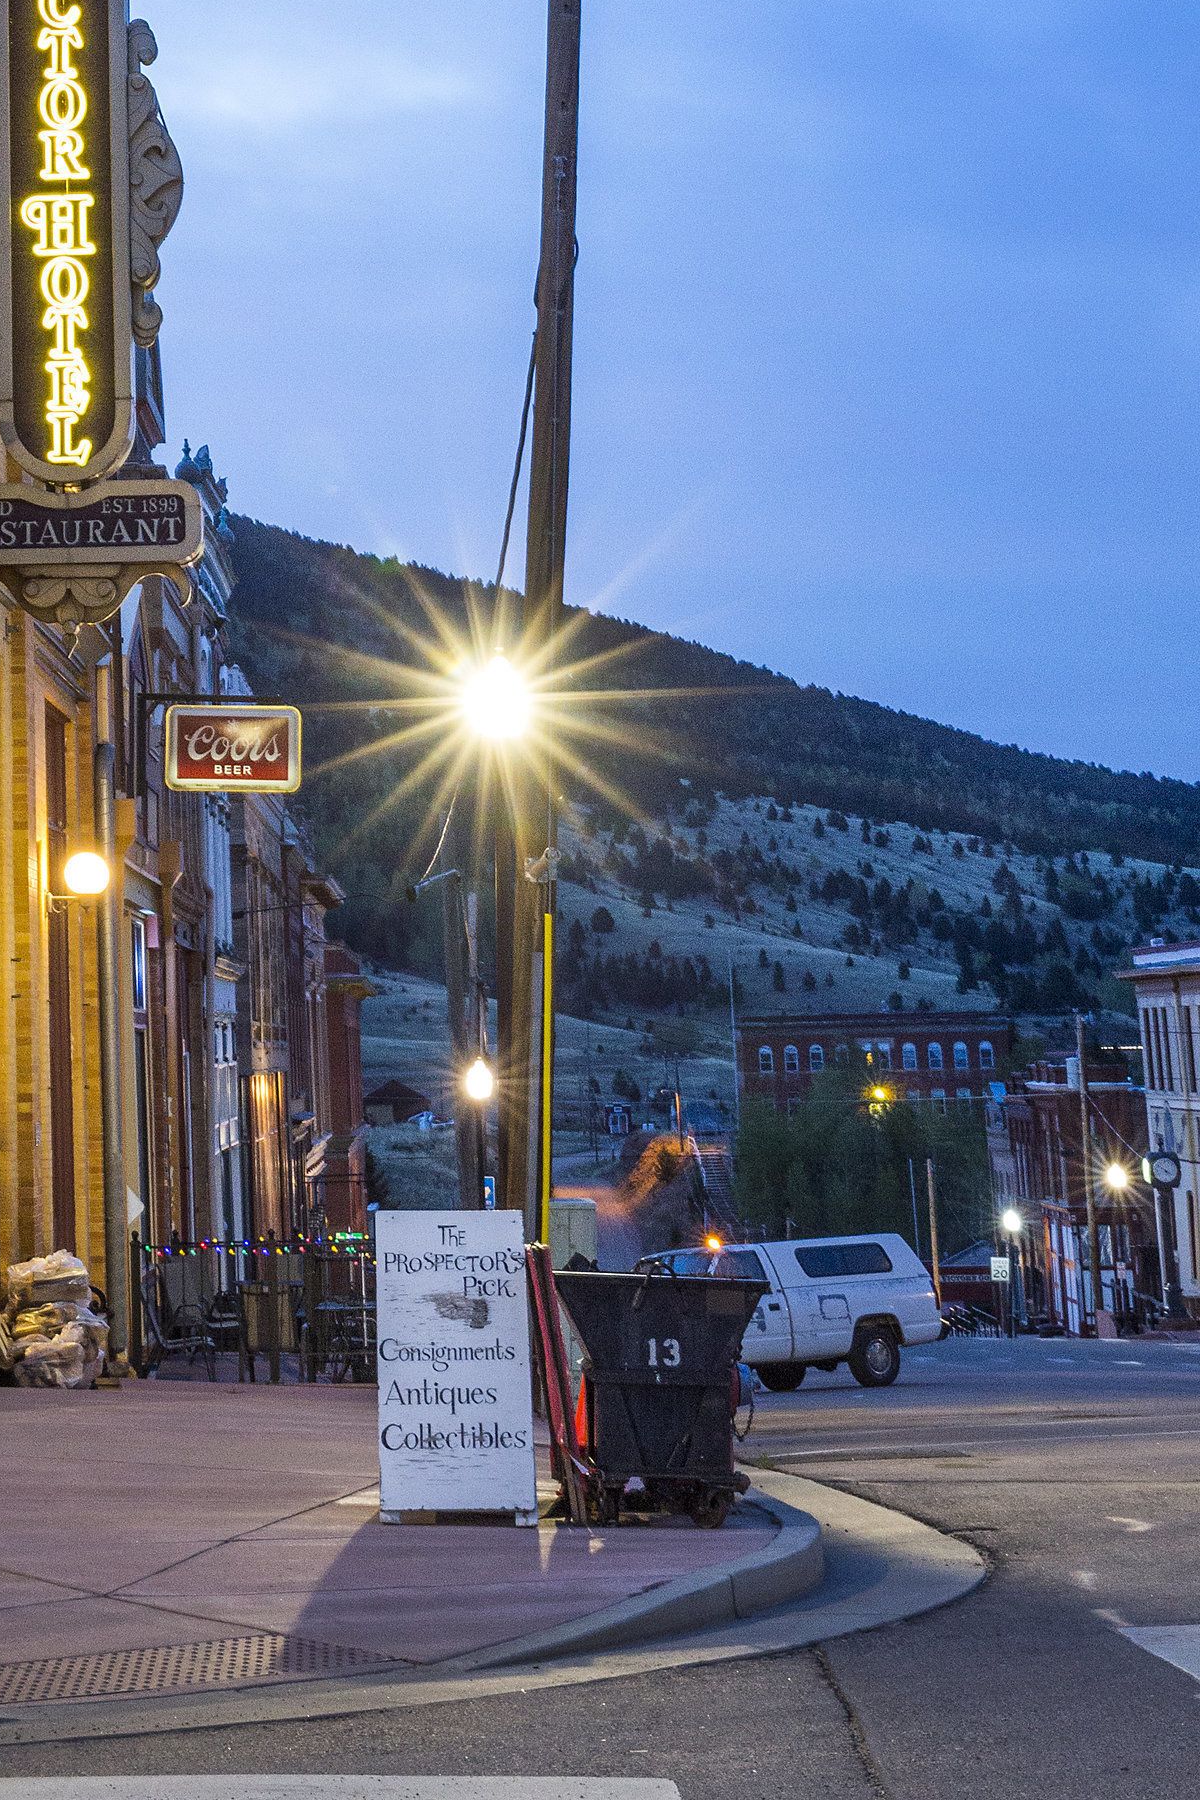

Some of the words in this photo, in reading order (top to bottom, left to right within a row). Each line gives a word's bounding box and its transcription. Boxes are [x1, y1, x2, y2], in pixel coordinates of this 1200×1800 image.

[19, 191, 97, 467] HOTEL
[101, 499, 136, 514] EST
[141, 497, 179, 513] 1899
[184, 724, 282, 762] Coors
[214, 764, 252, 776] BEER
[383, 1247, 526, 1275] PROSPECTOR'S
[993, 1269, 1008, 1279] 20
[378, 1337, 516, 1373] Consignments
[647, 1338, 681, 1367] 13
[384, 1378, 498, 1415] Antiques
[380, 1422, 527, 1451] Collectibles
